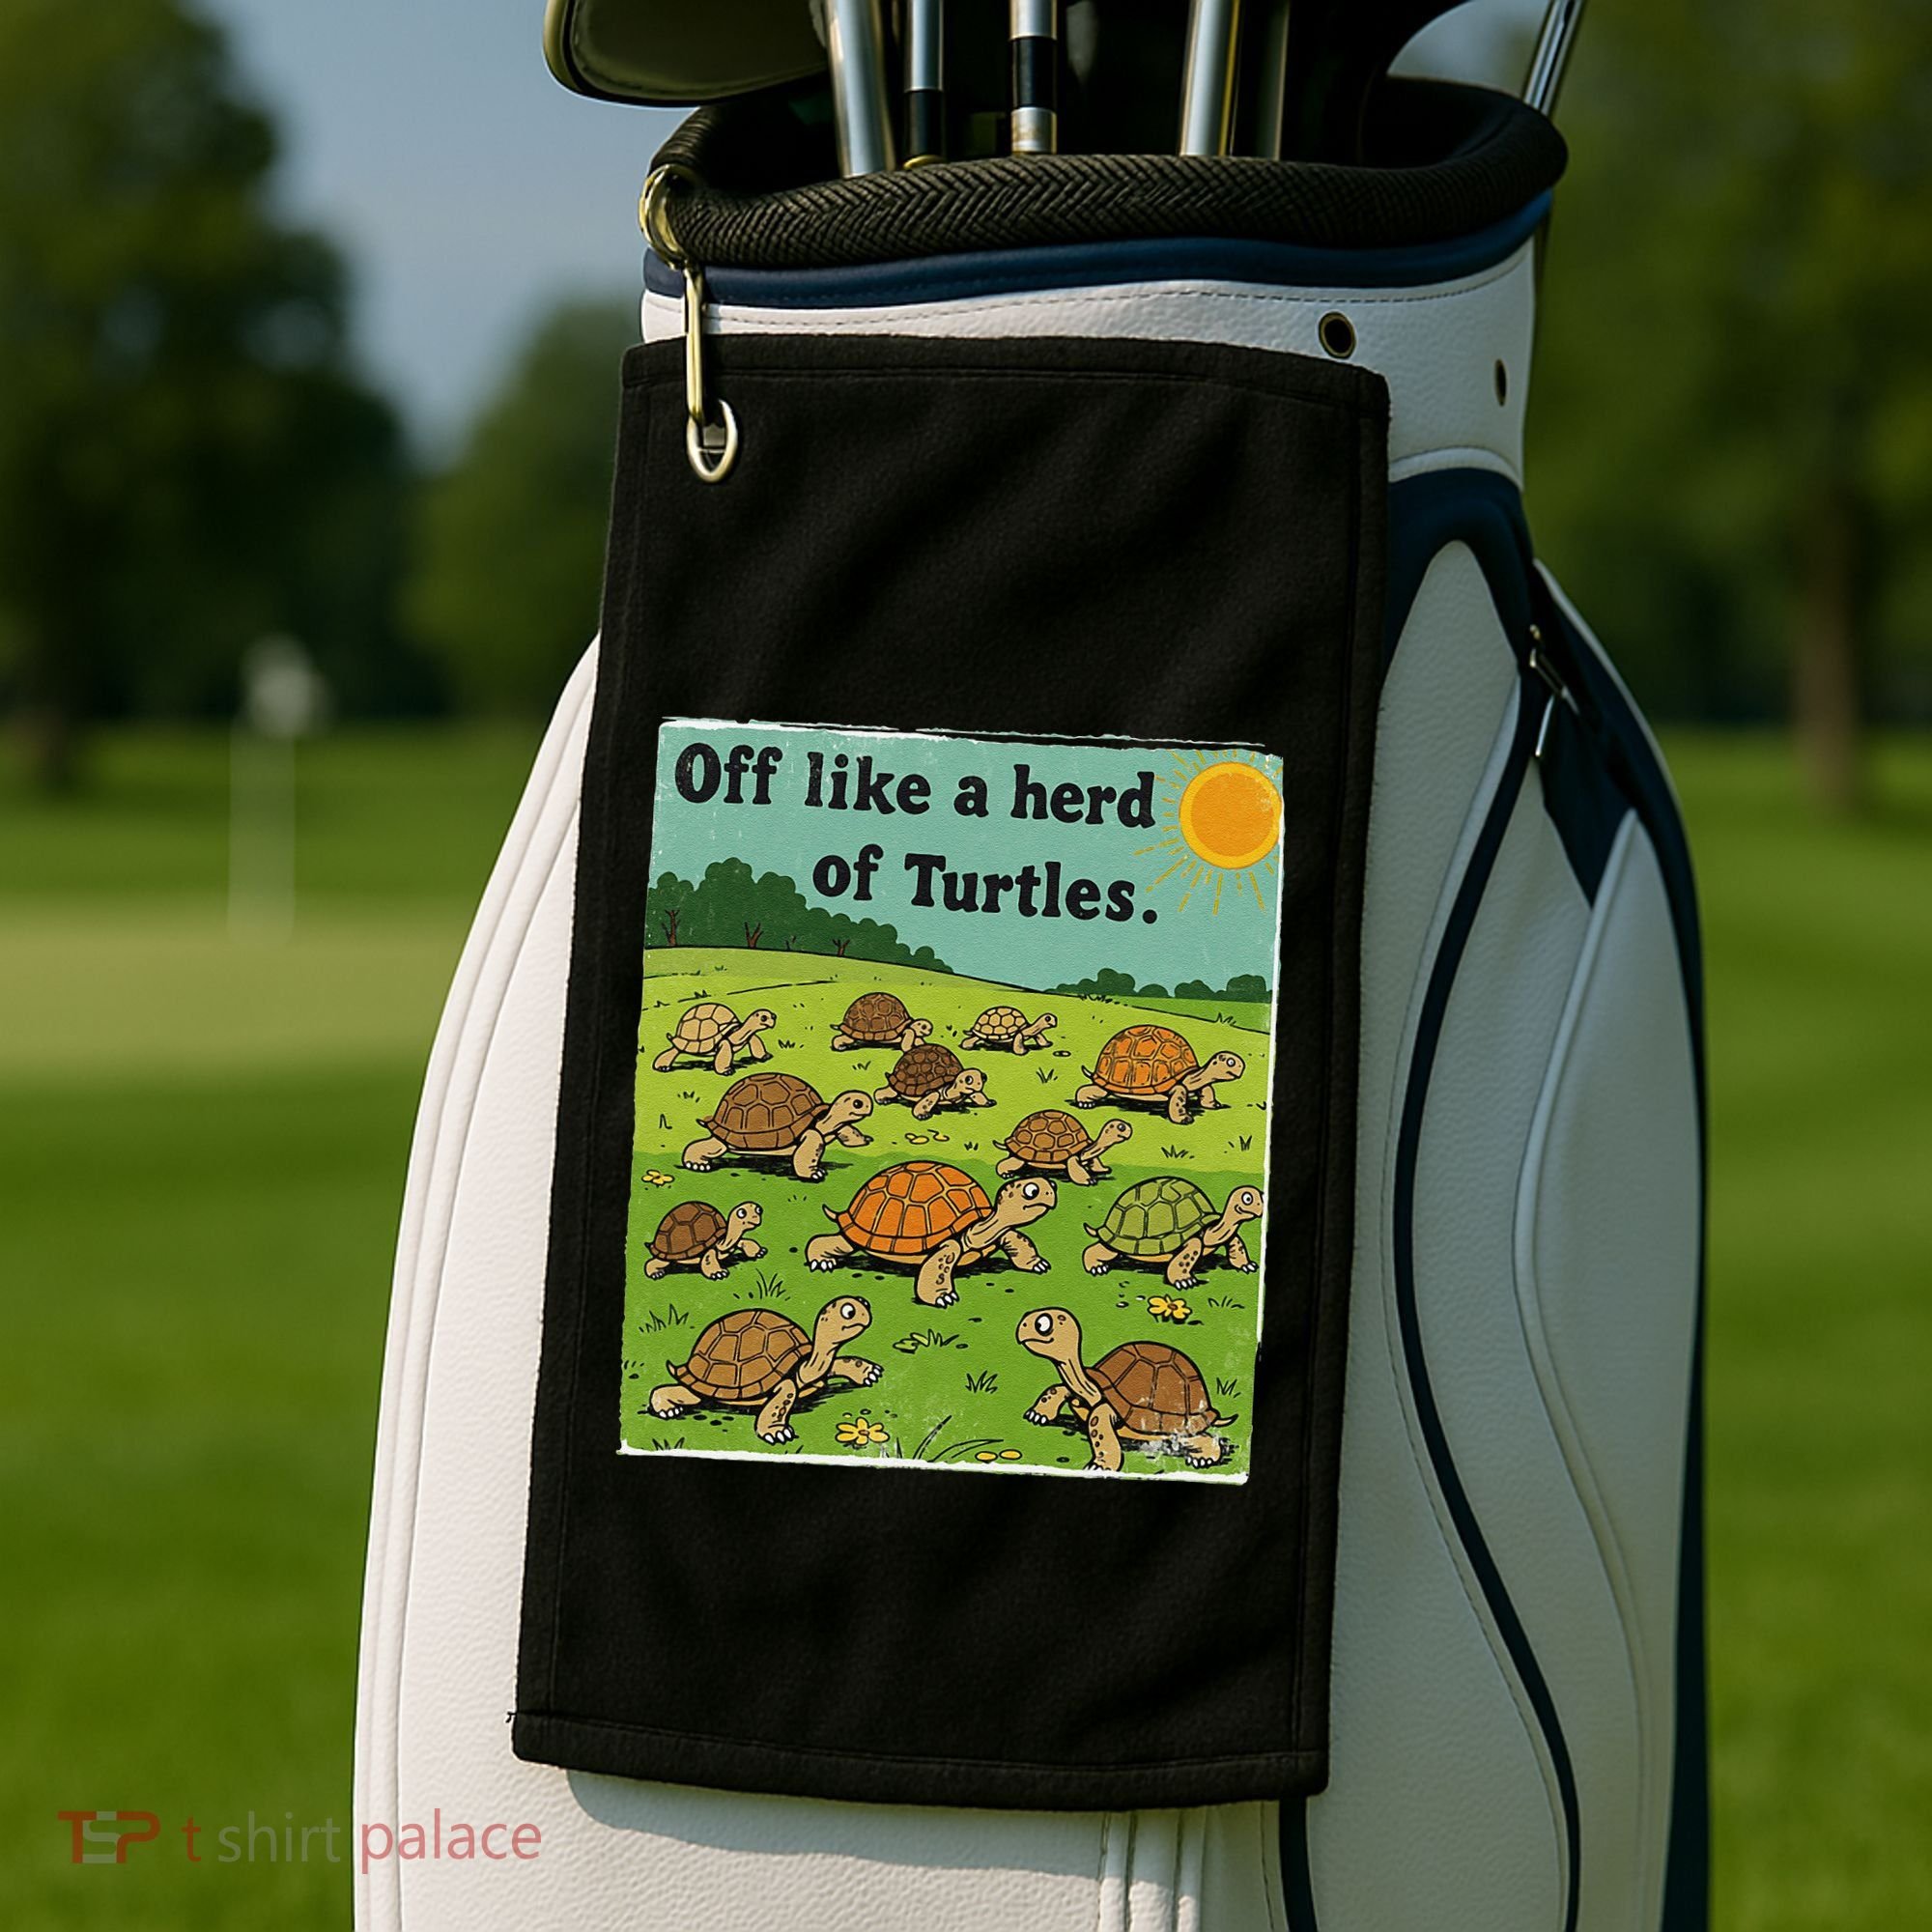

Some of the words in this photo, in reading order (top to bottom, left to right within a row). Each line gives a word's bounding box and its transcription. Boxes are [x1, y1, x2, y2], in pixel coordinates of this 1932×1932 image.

[676, 743, 783, 806] Off
[804, 752, 932, 815] like
[953, 776, 989, 817] a
[1010, 764, 1156, 829] herd
[812, 844, 884, 901] of
[904, 852, 1158, 924] Turtles.
